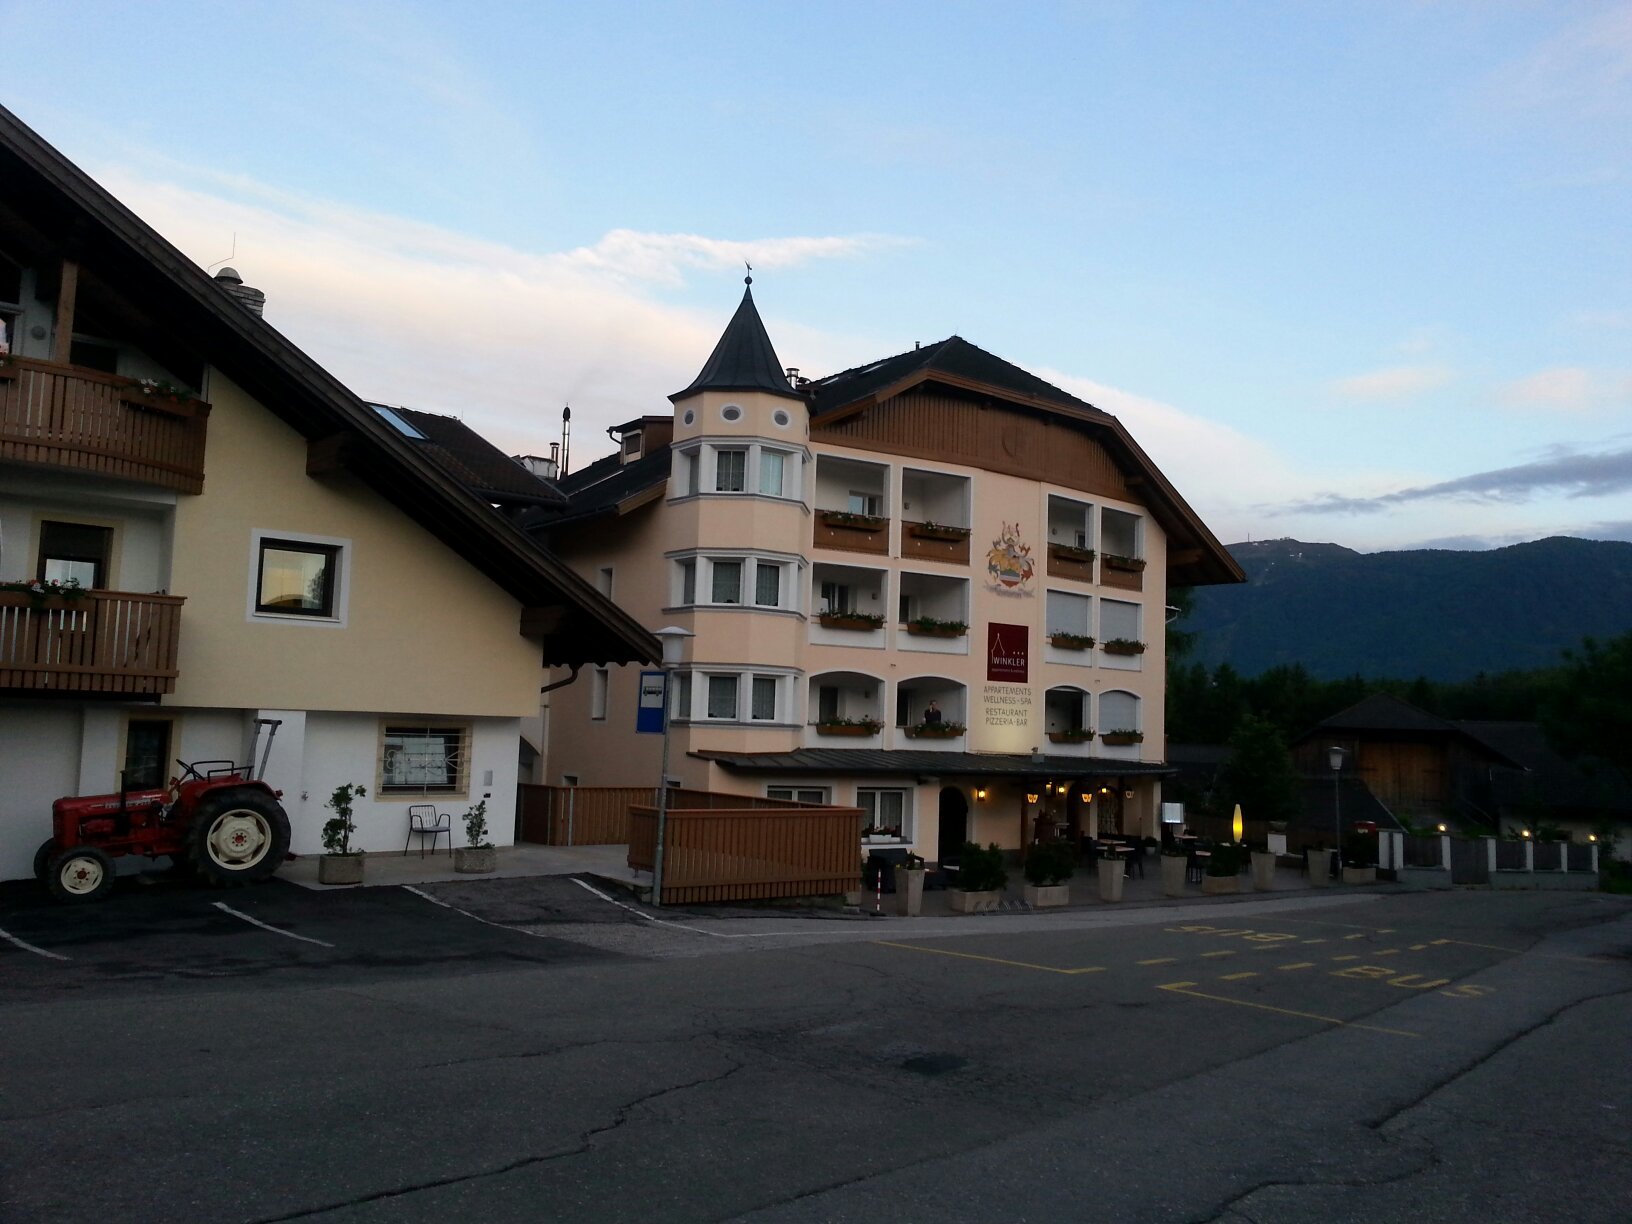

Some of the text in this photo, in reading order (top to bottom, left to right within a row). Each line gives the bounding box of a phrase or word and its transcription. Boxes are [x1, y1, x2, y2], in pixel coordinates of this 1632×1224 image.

[993, 656, 1025, 667] WINKLER
[983, 685, 1032, 696] APPARTEMENTS
[985, 707, 1028, 717] RESTAURANT
[1328, 965, 1497, 998] BUS
